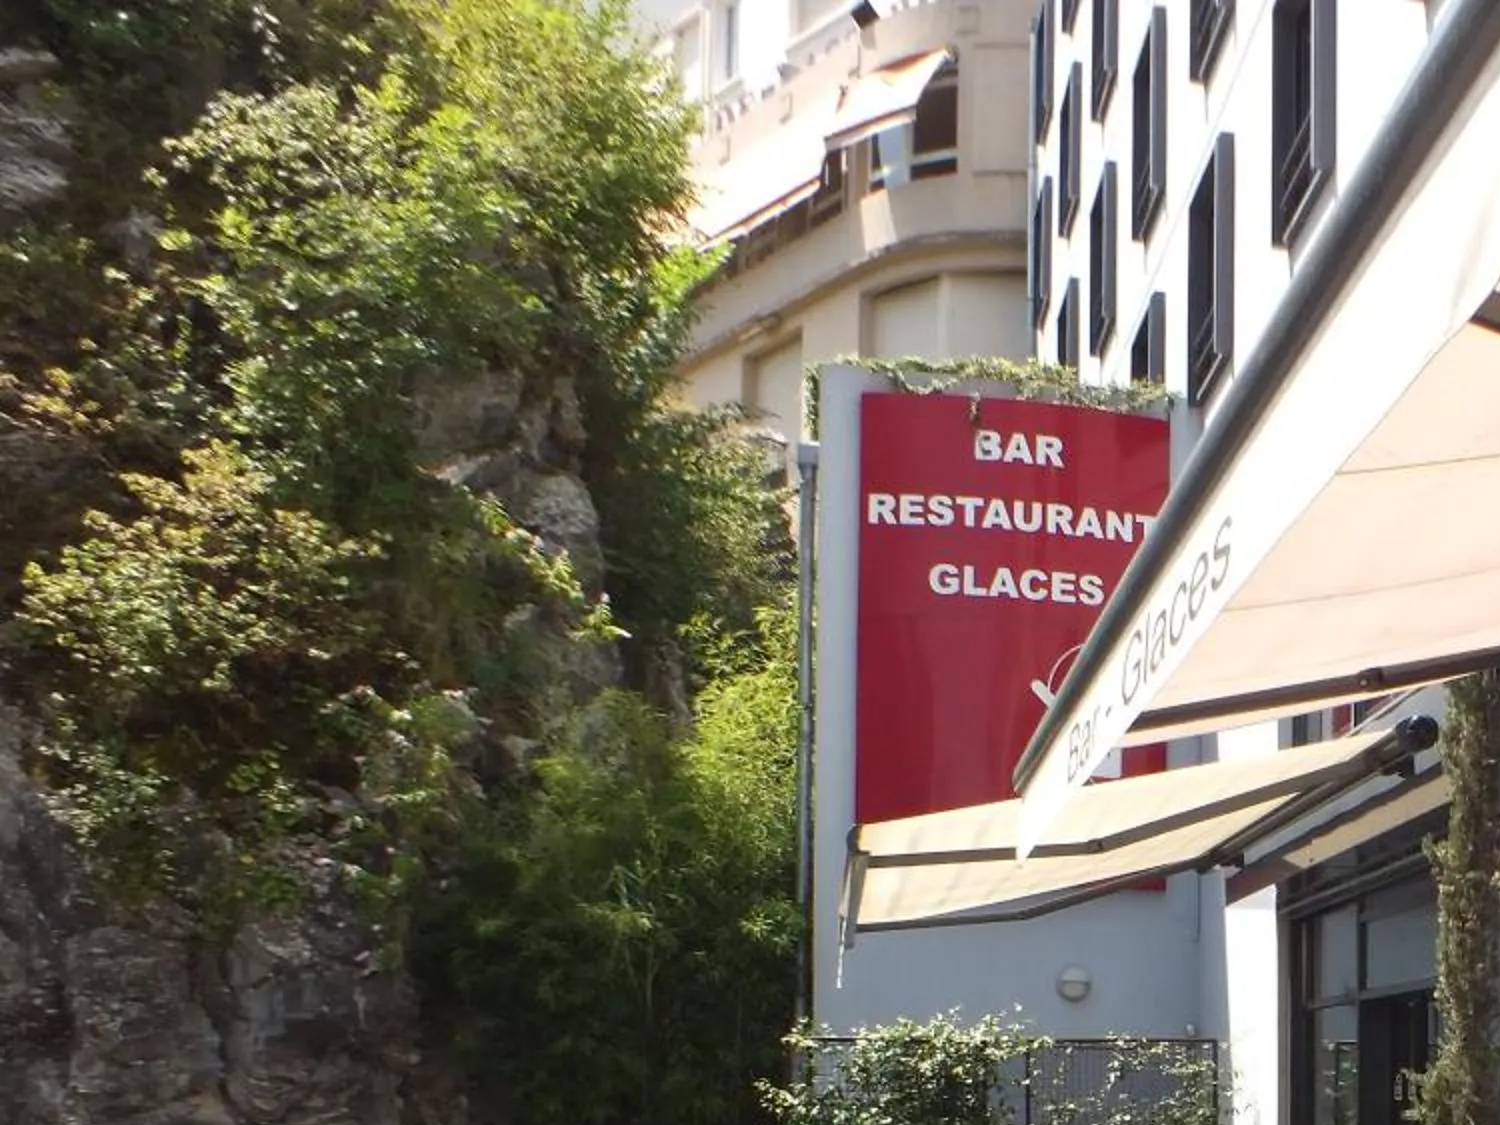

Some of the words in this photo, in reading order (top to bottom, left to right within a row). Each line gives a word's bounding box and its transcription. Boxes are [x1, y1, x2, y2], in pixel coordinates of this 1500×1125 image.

[974, 430, 1065, 467] BAR
[867, 493, 1158, 542] RESTAURANT
[929, 563, 1105, 605] GLACES
[1067, 705, 1101, 785] Bar
[1121, 515, 1234, 705] Glaces
